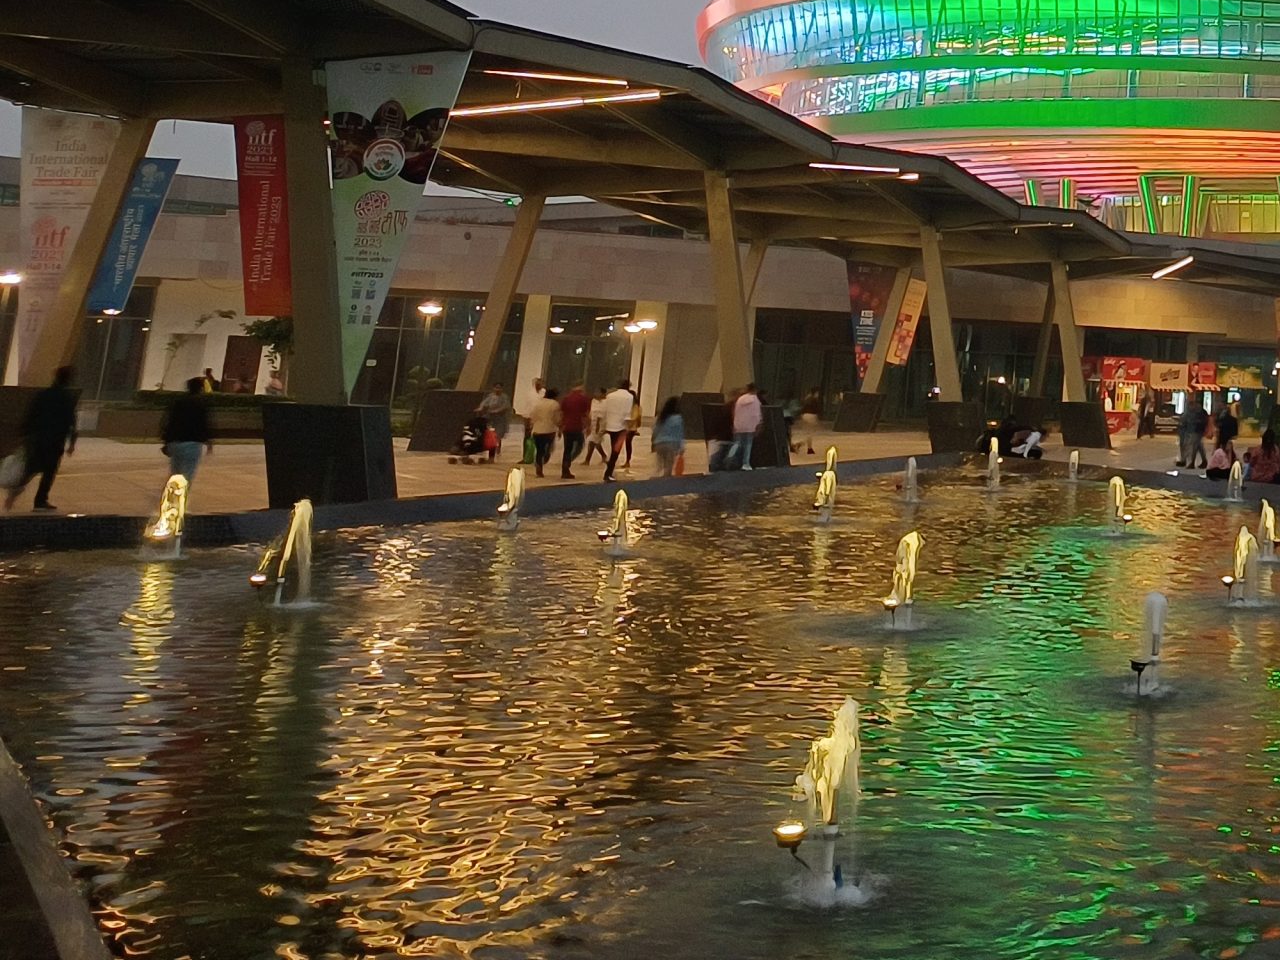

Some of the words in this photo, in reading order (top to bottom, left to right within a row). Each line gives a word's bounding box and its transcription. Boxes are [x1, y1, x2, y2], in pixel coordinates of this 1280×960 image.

[55, 140, 86, 152] India
[30, 152, 108, 165] International
[36, 166, 70, 177] Trade
[73, 166, 99, 178] Fair
[252, 181, 270, 250] International
[270, 196, 281, 224] 2023
[35, 226, 70, 247] iitf
[264, 226, 277, 248] Fair
[354, 238, 382, 248] 2023
[248, 254, 261, 282] India
[260, 251, 273, 281] Trade
